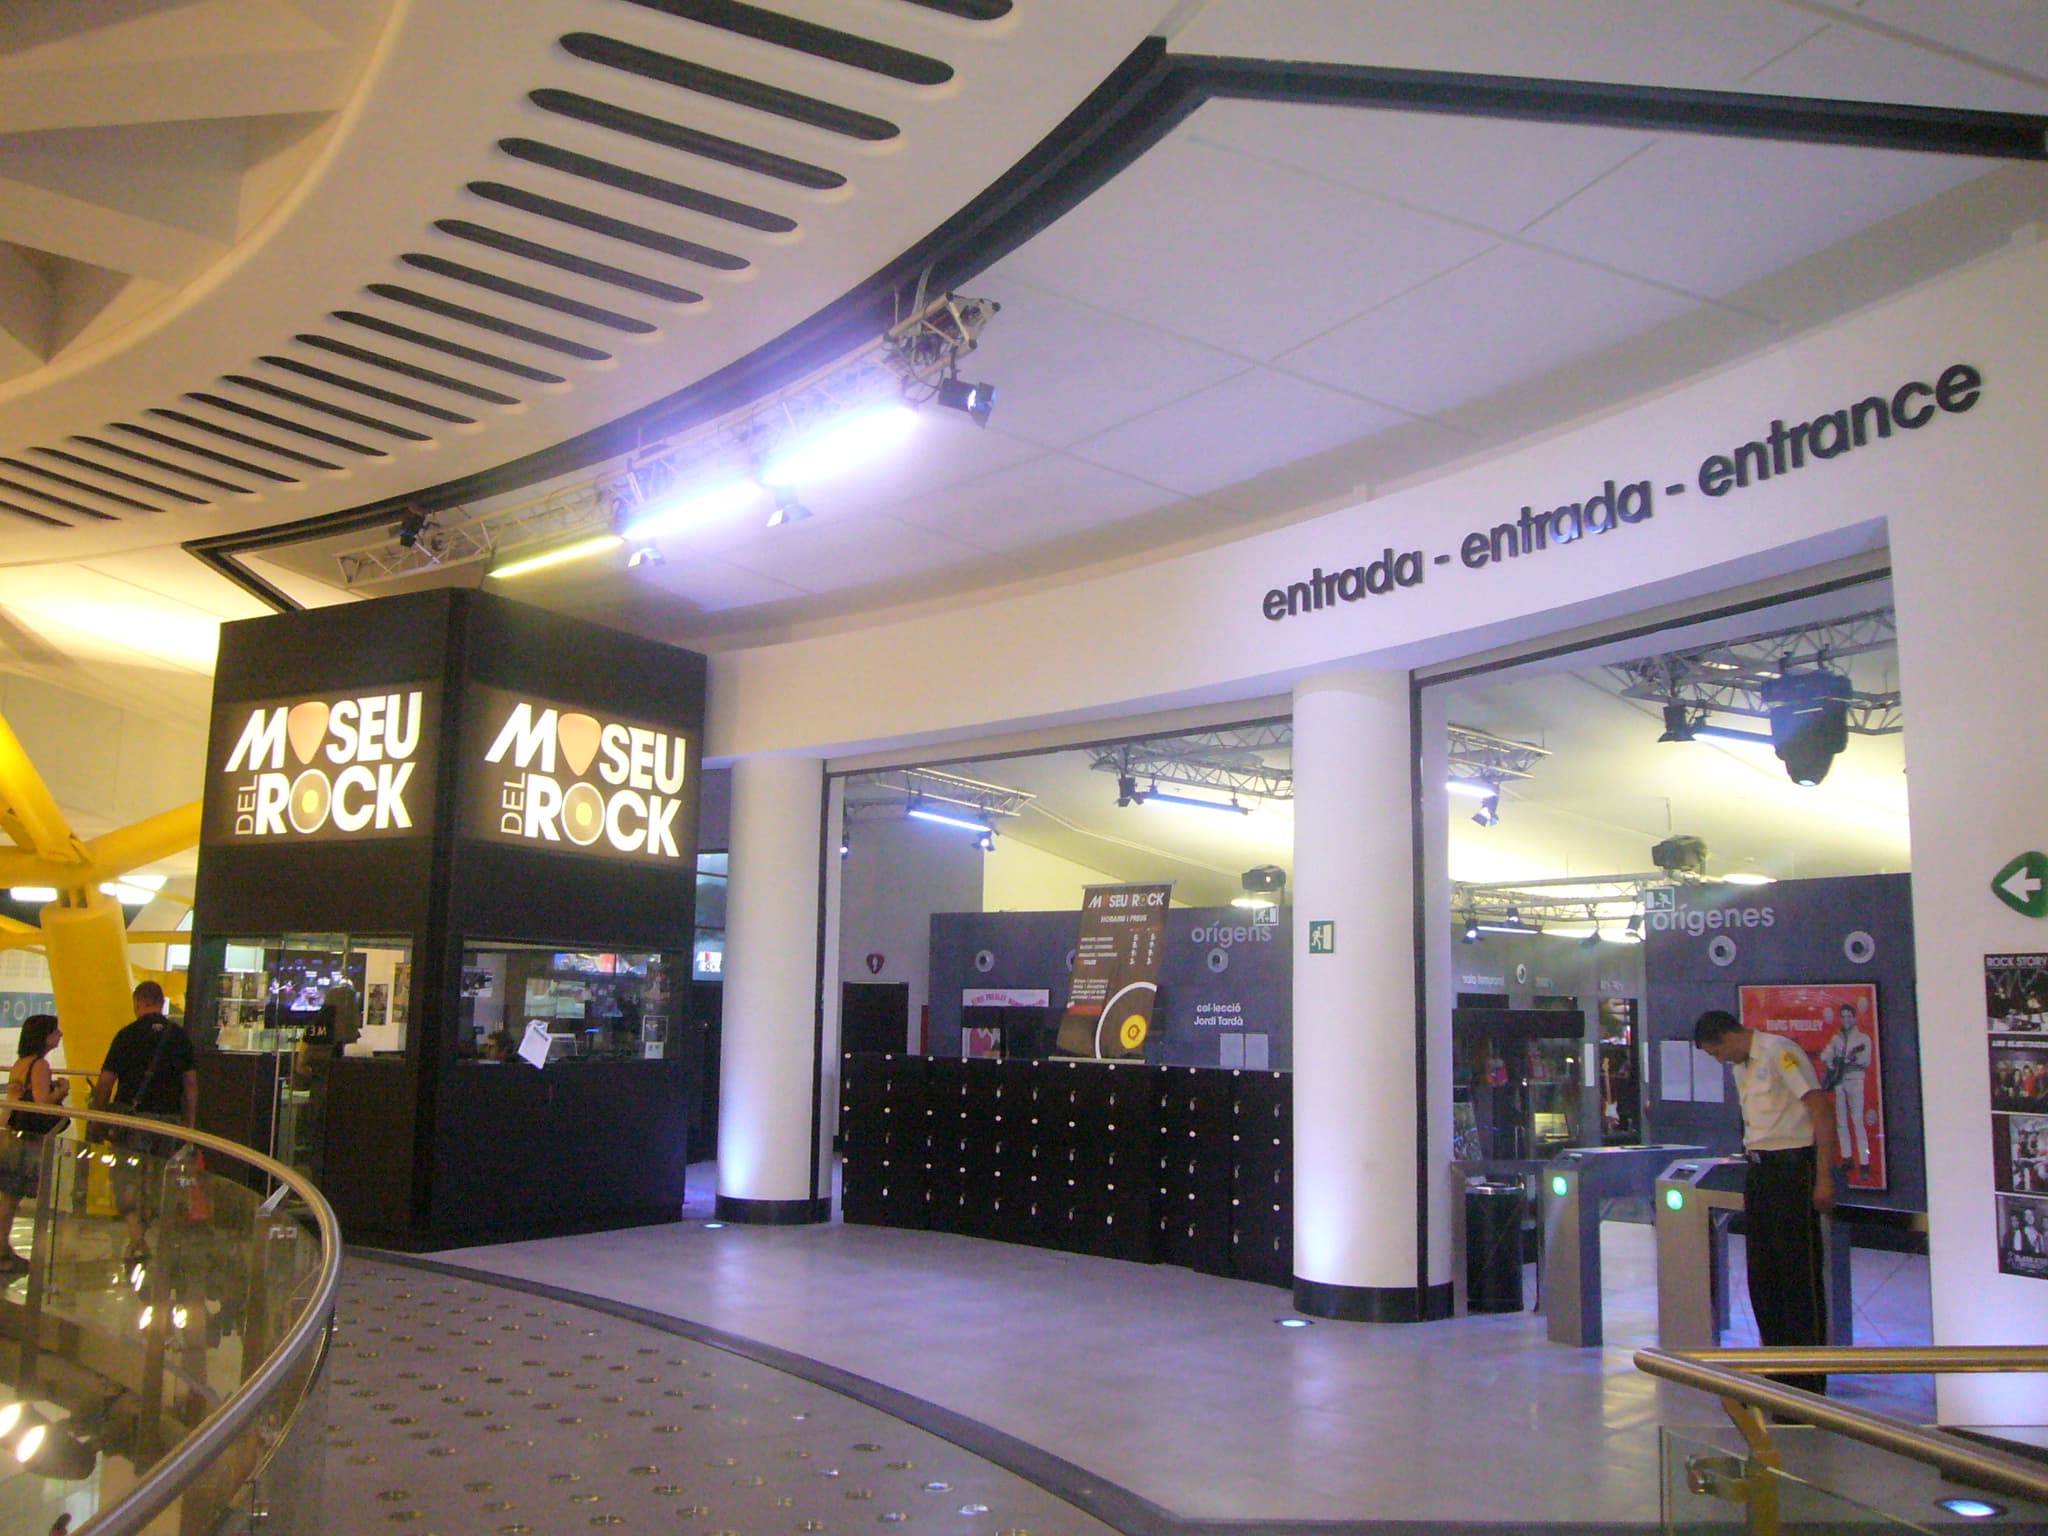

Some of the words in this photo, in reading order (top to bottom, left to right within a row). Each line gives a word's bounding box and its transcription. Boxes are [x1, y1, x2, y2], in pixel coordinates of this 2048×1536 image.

[1263, 548, 1422, 620] entrada
[1461, 480, 1652, 568] entrada
[1698, 364, 1981, 497] entrance
[235, 774, 259, 834] DEL
[501, 772, 526, 835] DEL
[1652, 903, 1775, 937] orígenes
